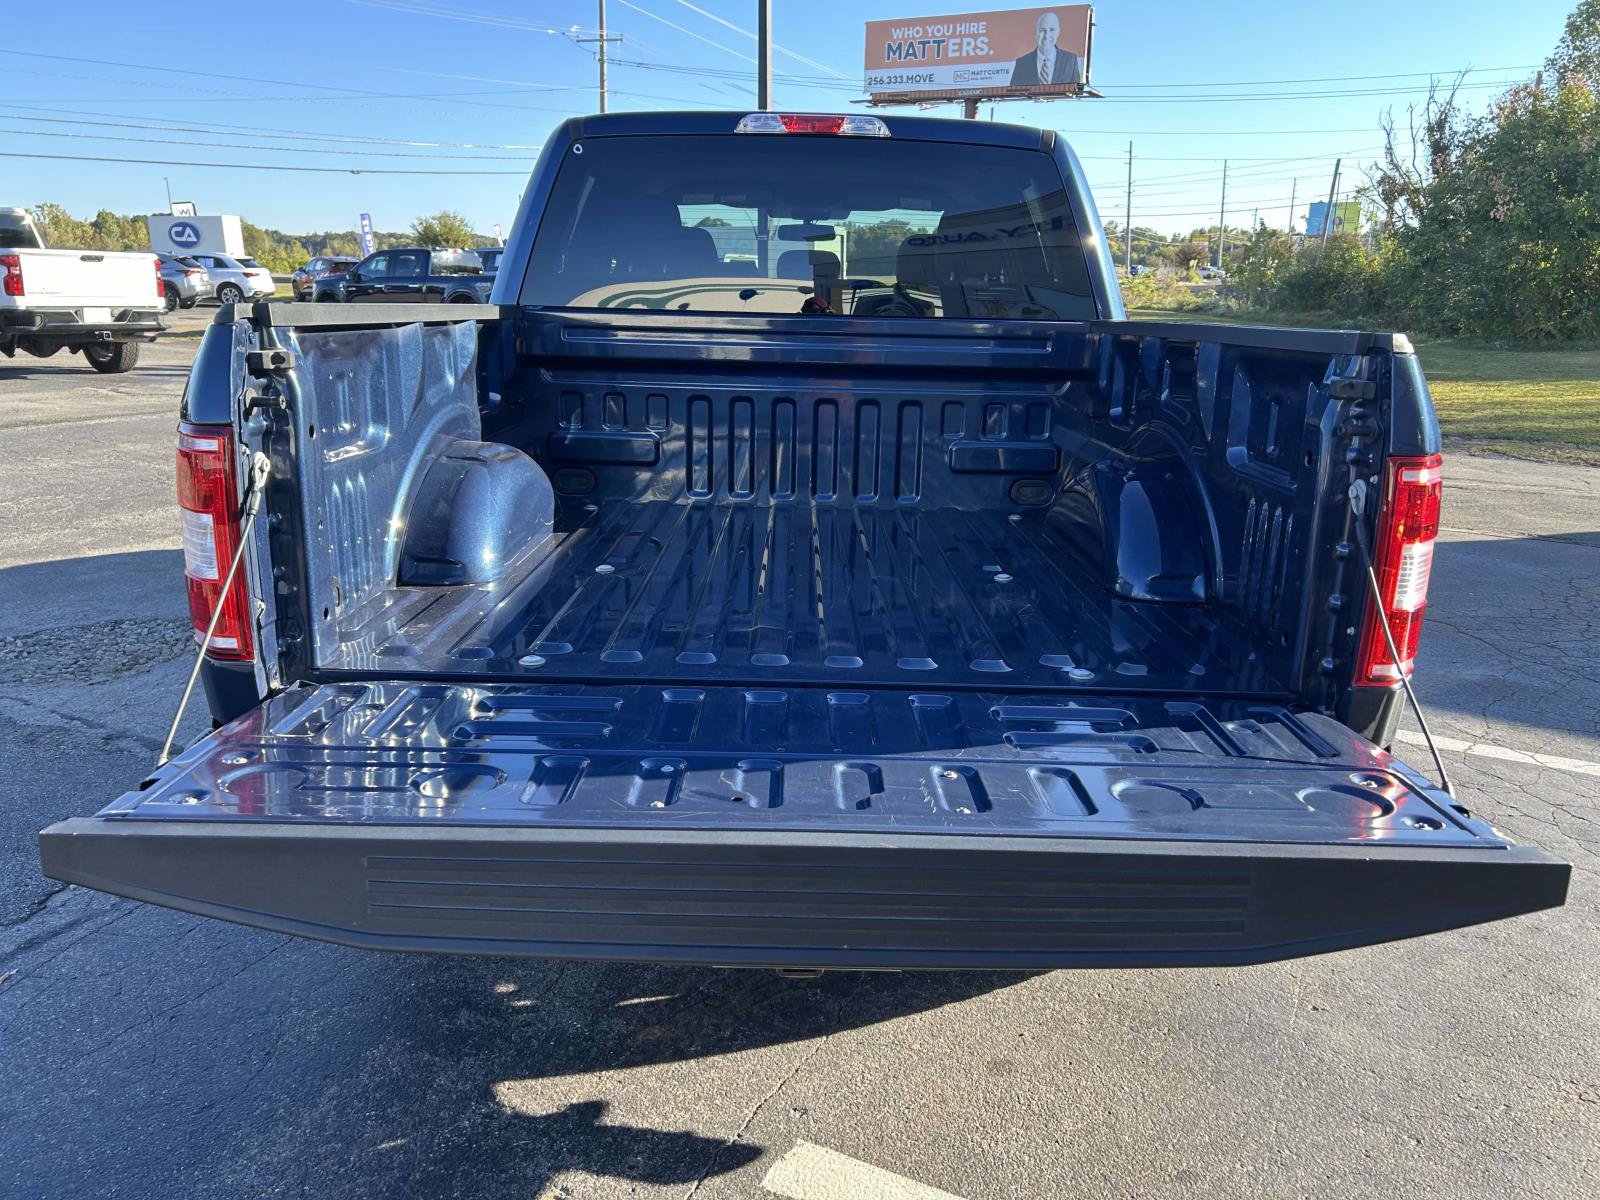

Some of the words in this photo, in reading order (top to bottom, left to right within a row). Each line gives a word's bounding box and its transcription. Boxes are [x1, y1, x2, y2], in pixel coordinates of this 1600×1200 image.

[891, 26, 923, 39] WHO
[926, 24, 953, 37] YOU
[956, 21, 987, 35] HIRE
[885, 36, 994, 63] MATTERS.
[867, 73, 935, 86] 256.333.MOVE
[170, 226, 198, 242] CA
